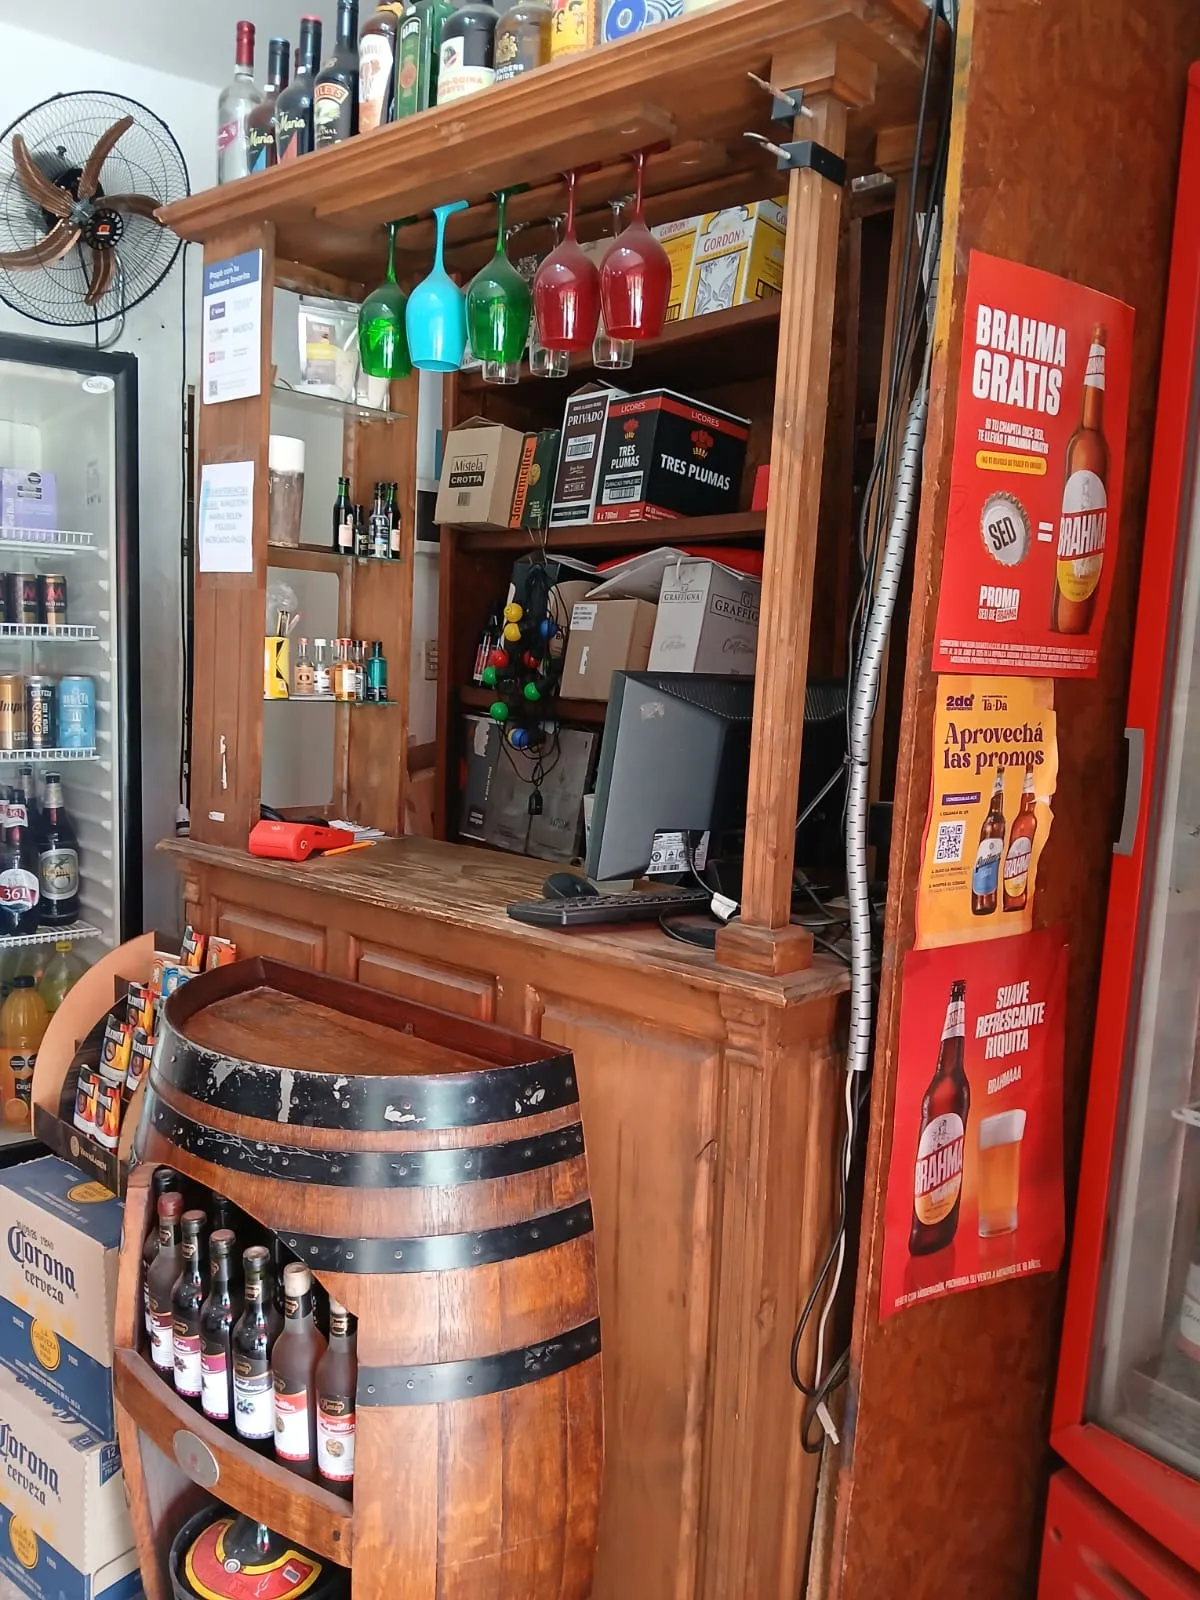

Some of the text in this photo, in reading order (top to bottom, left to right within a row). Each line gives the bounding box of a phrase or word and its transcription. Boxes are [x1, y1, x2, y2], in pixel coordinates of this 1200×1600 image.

[976, 304, 1066, 368] BRAHMA
[972, 348, 1063, 416] GRATIS
[567, 410, 604, 427] PRIVADO
[620, 401, 647, 413] LICORES
[691, 410, 720, 428] LICORES
[611, 455, 640, 470] PLUMAS
[619, 444, 636, 458] TRES
[454, 457, 484, 473] Mistela
[660, 453, 731, 491] TRES PLUMAS
[450, 475, 483, 485] CROTTA
[988, 516, 1017, 551] SED
[664, 592, 701, 602] GRAFFIGNA
[979, 585, 1020, 609] PROMO
[714, 600, 759, 622] GRAFFIG
[988, 608, 996, 621] DE
[944, 721, 1043, 752] Aprovechá
[943, 746, 1045, 776] las promos
[4, 887, 28, 900] 361
[996, 980, 1030, 1010] SUAVE
[975, 1001, 1046, 1039] REFRESCANTE
[984, 1029, 1029, 1060] RIQUITA
[16, 1082, 32, 1092] Cepi
[987, 1065, 1022, 1095] BRAHMAAA
[8, 1224, 76, 1293] Corona
[24, 1268, 65, 1305] cerveza
[7, 1464, 46, 1507] cerveza
